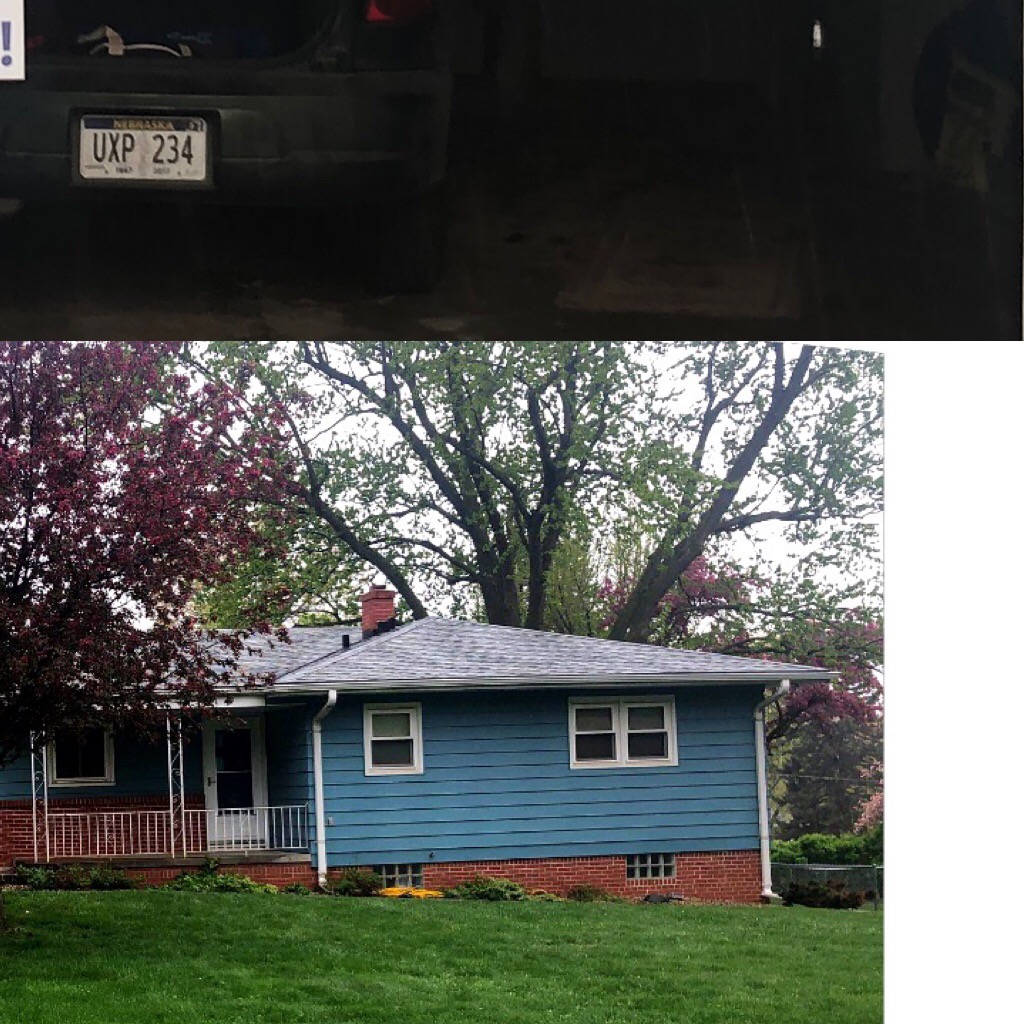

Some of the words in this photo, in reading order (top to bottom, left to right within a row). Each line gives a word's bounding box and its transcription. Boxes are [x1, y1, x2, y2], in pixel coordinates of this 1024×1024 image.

[113, 119, 175, 130] NEBRASKA
[93, 133, 135, 163] UXP
[152, 134, 193, 165] 234
